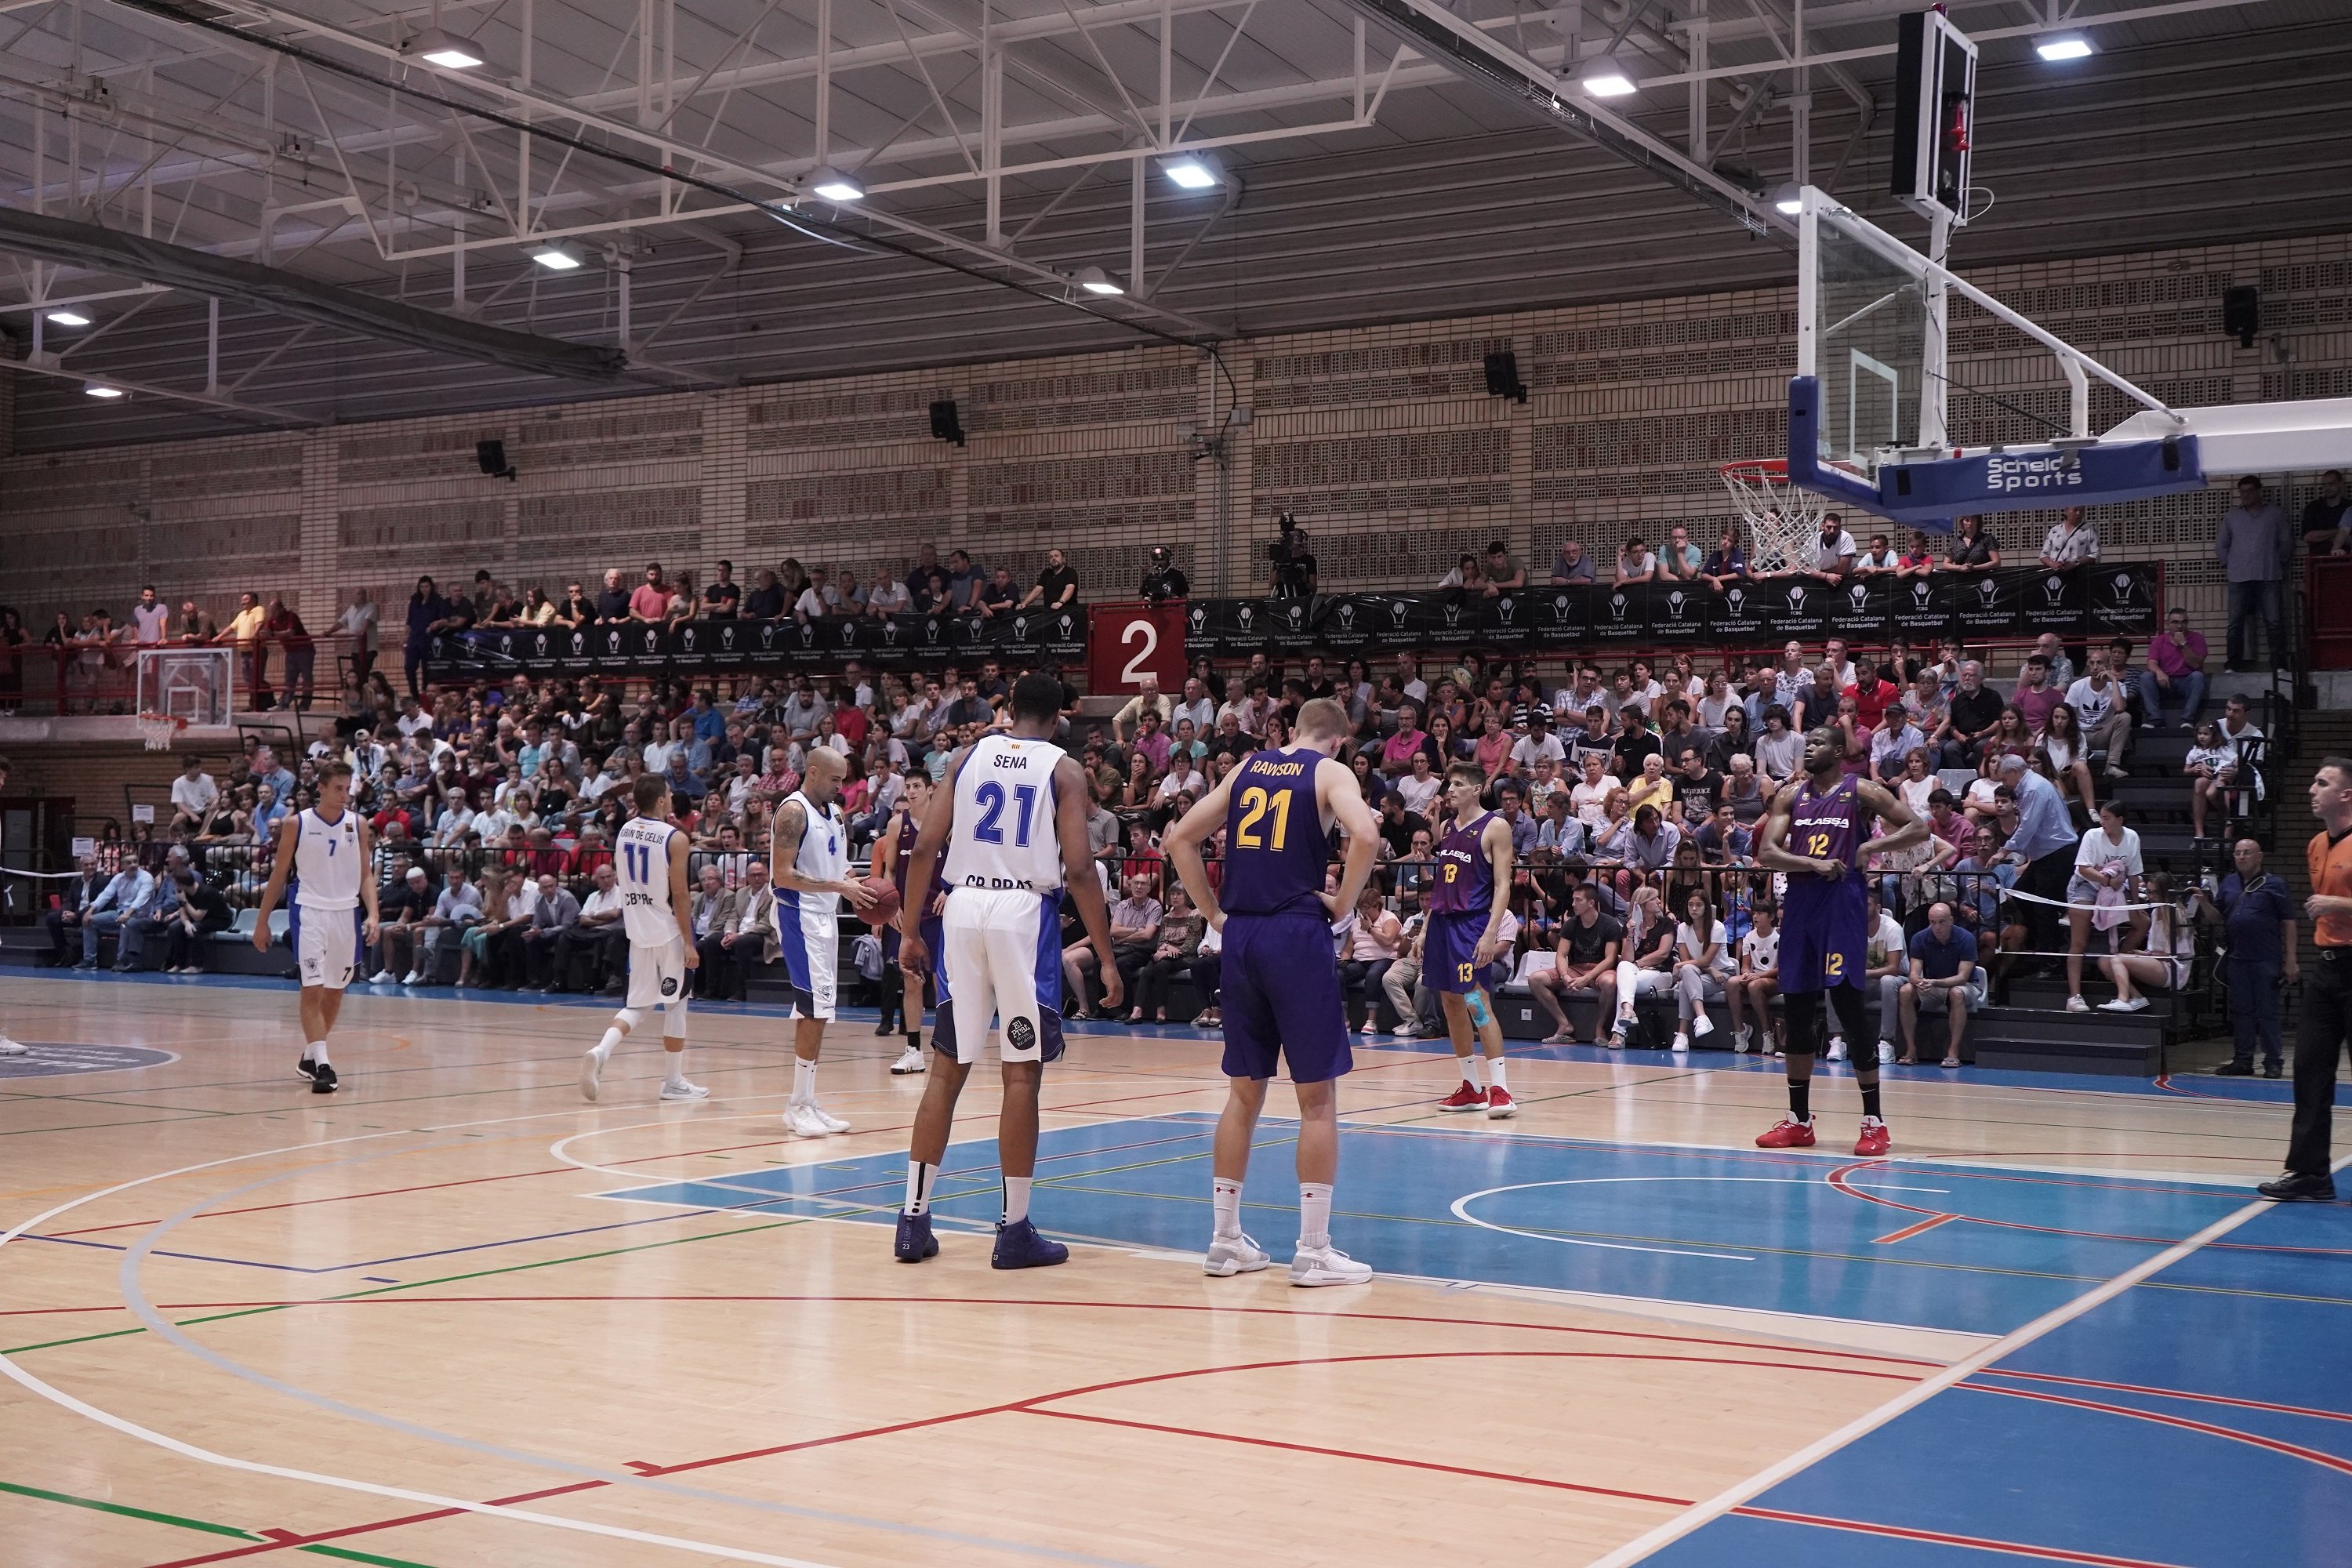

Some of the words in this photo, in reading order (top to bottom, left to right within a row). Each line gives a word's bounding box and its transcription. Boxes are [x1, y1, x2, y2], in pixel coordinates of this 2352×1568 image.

[1987, 472, 2082, 492] Sports
[1975, 617, 2009, 626] Basquetbol
[2042, 615, 2076, 623] Basquetbol
[2110, 612, 2145, 621] Basquetbol
[1120, 619, 1158, 684] 2
[993, 754, 1027, 770] SENA
[1250, 760, 1304, 776] RAWSON
[973, 780, 1037, 848] 21
[1236, 786, 1293, 852] 21
[636, 830, 644, 840] DE
[644, 832, 665, 844] CELIS
[828, 836, 837, 855] 4
[1807, 833, 1829, 856] 12
[328, 839, 336, 857] 7
[623, 842, 650, 885] 11
[1443, 863, 1458, 884] 13
[341, 967, 352, 982] 7
[1457, 963, 1473, 983] 13
[1012, 1020, 1023, 1030] El
